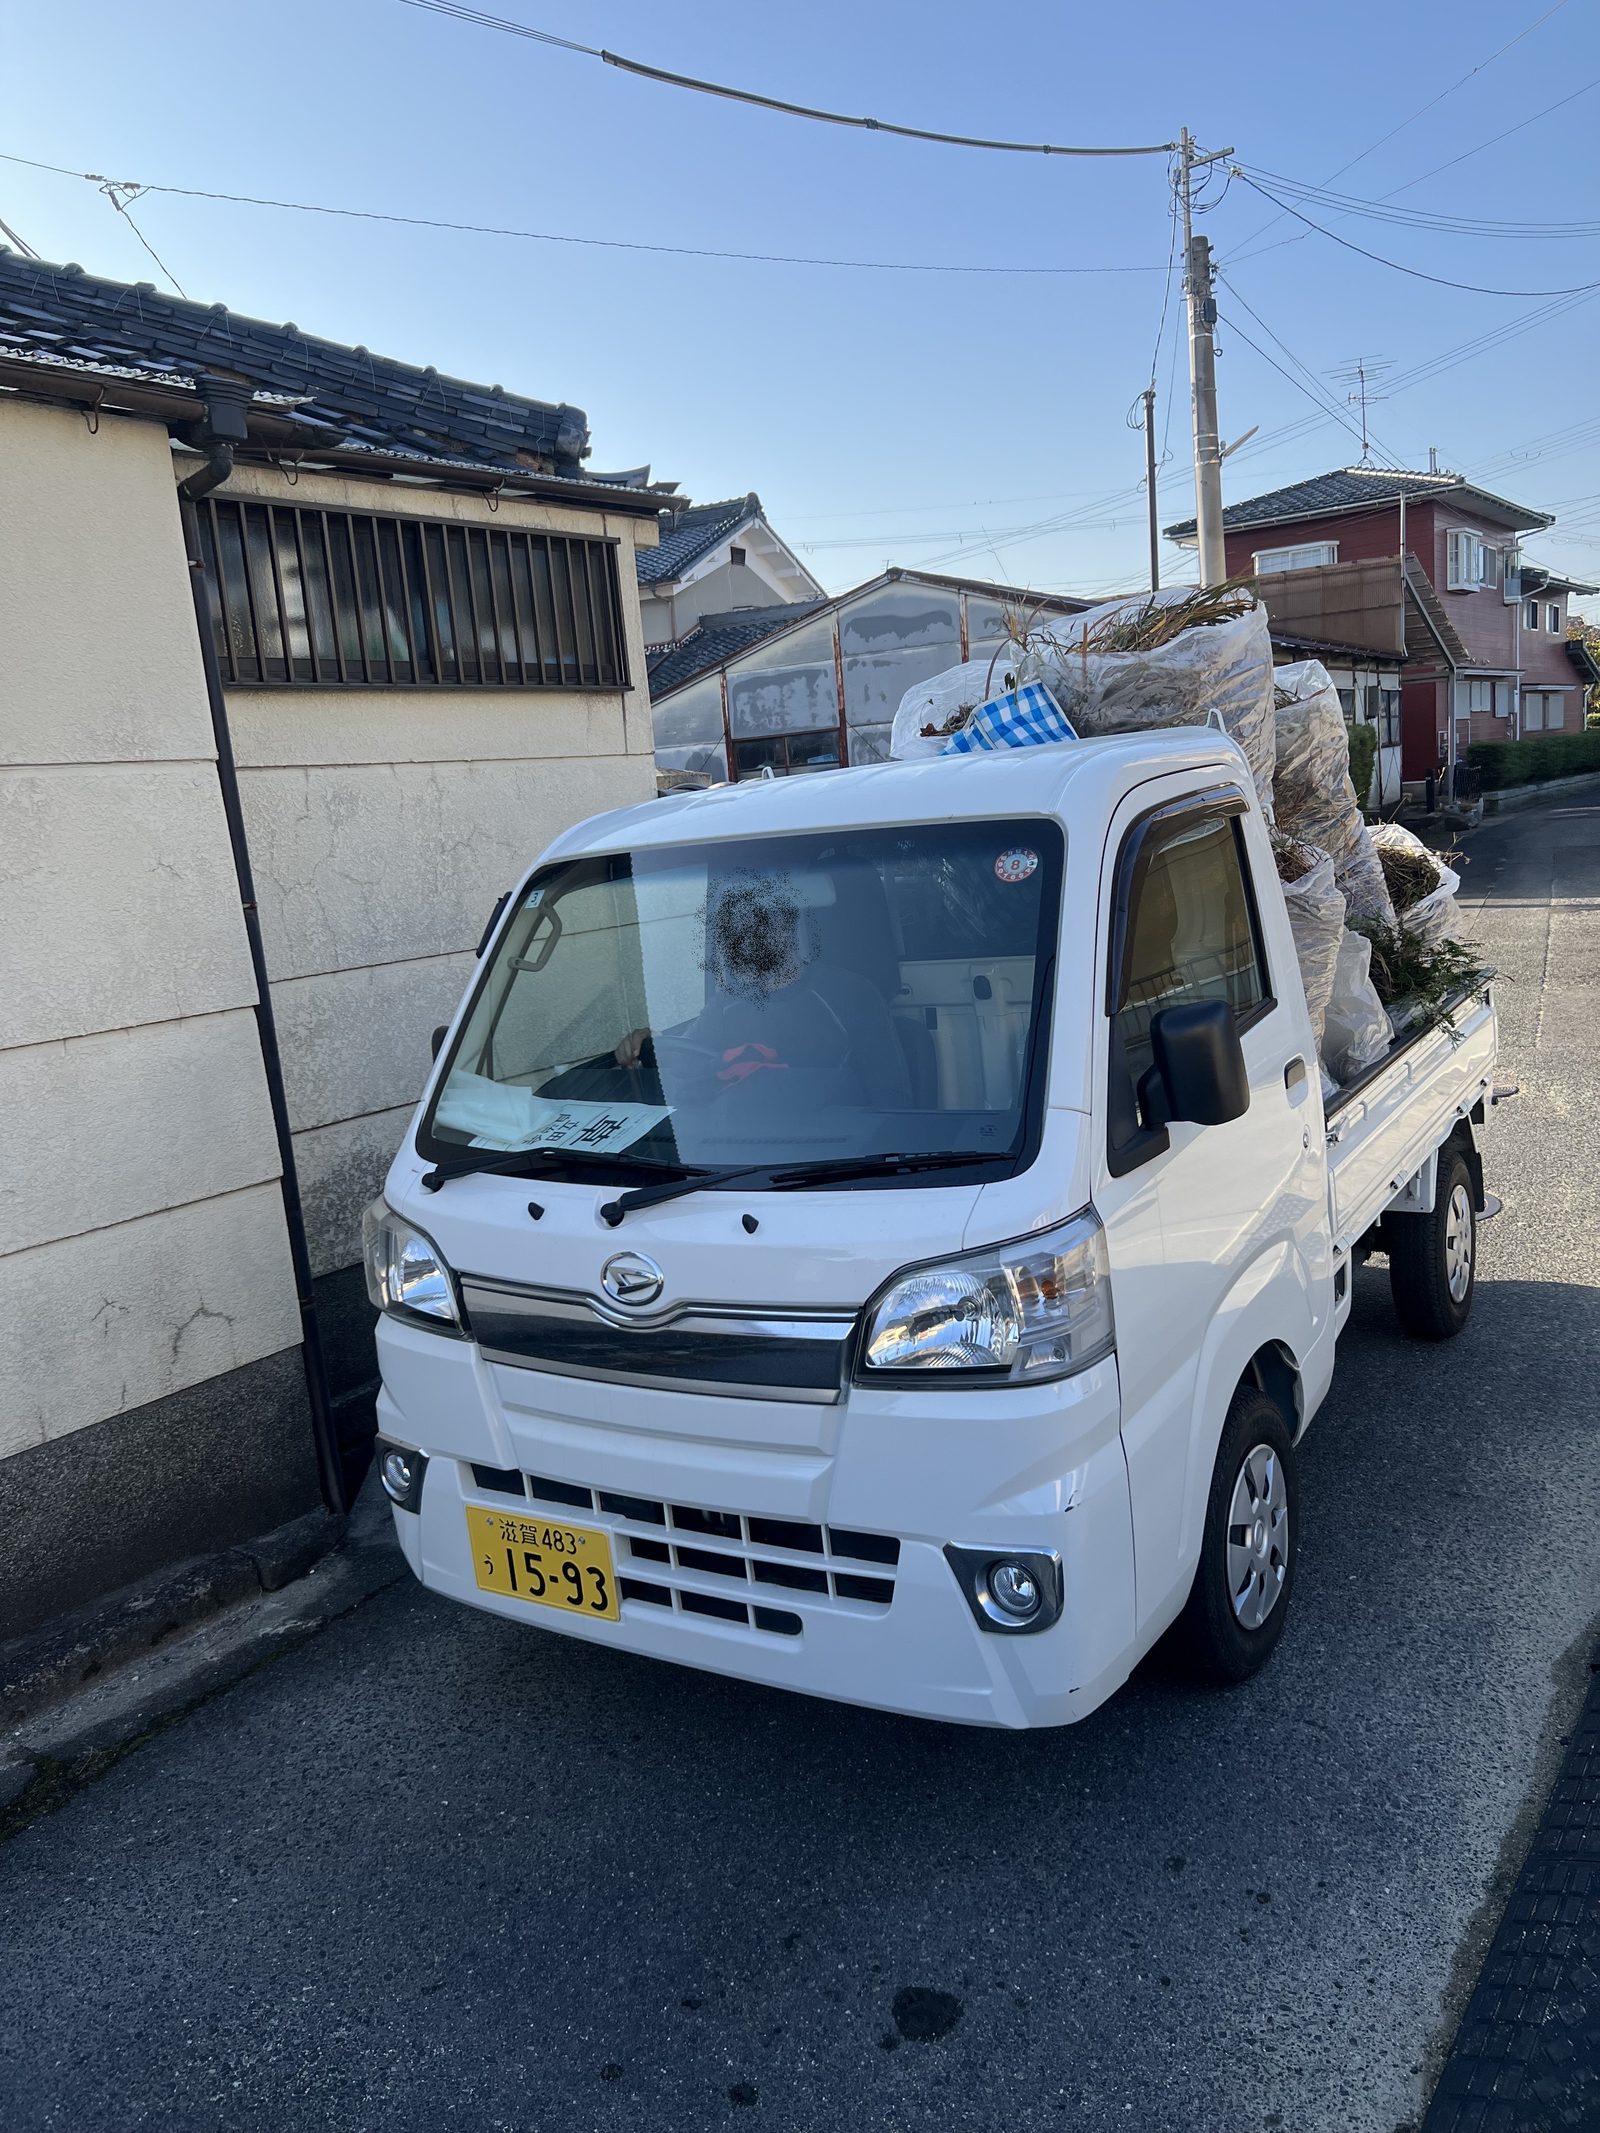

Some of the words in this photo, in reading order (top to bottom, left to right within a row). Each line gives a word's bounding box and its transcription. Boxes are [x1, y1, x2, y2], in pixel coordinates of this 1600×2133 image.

[1011, 859, 1020, 870] 8
[545, 1120, 580, 1142] 立田
[571, 1114, 629, 1147] 草
[484, 1554, 494, 1575] う
[506, 1548, 608, 1611] 15-93
